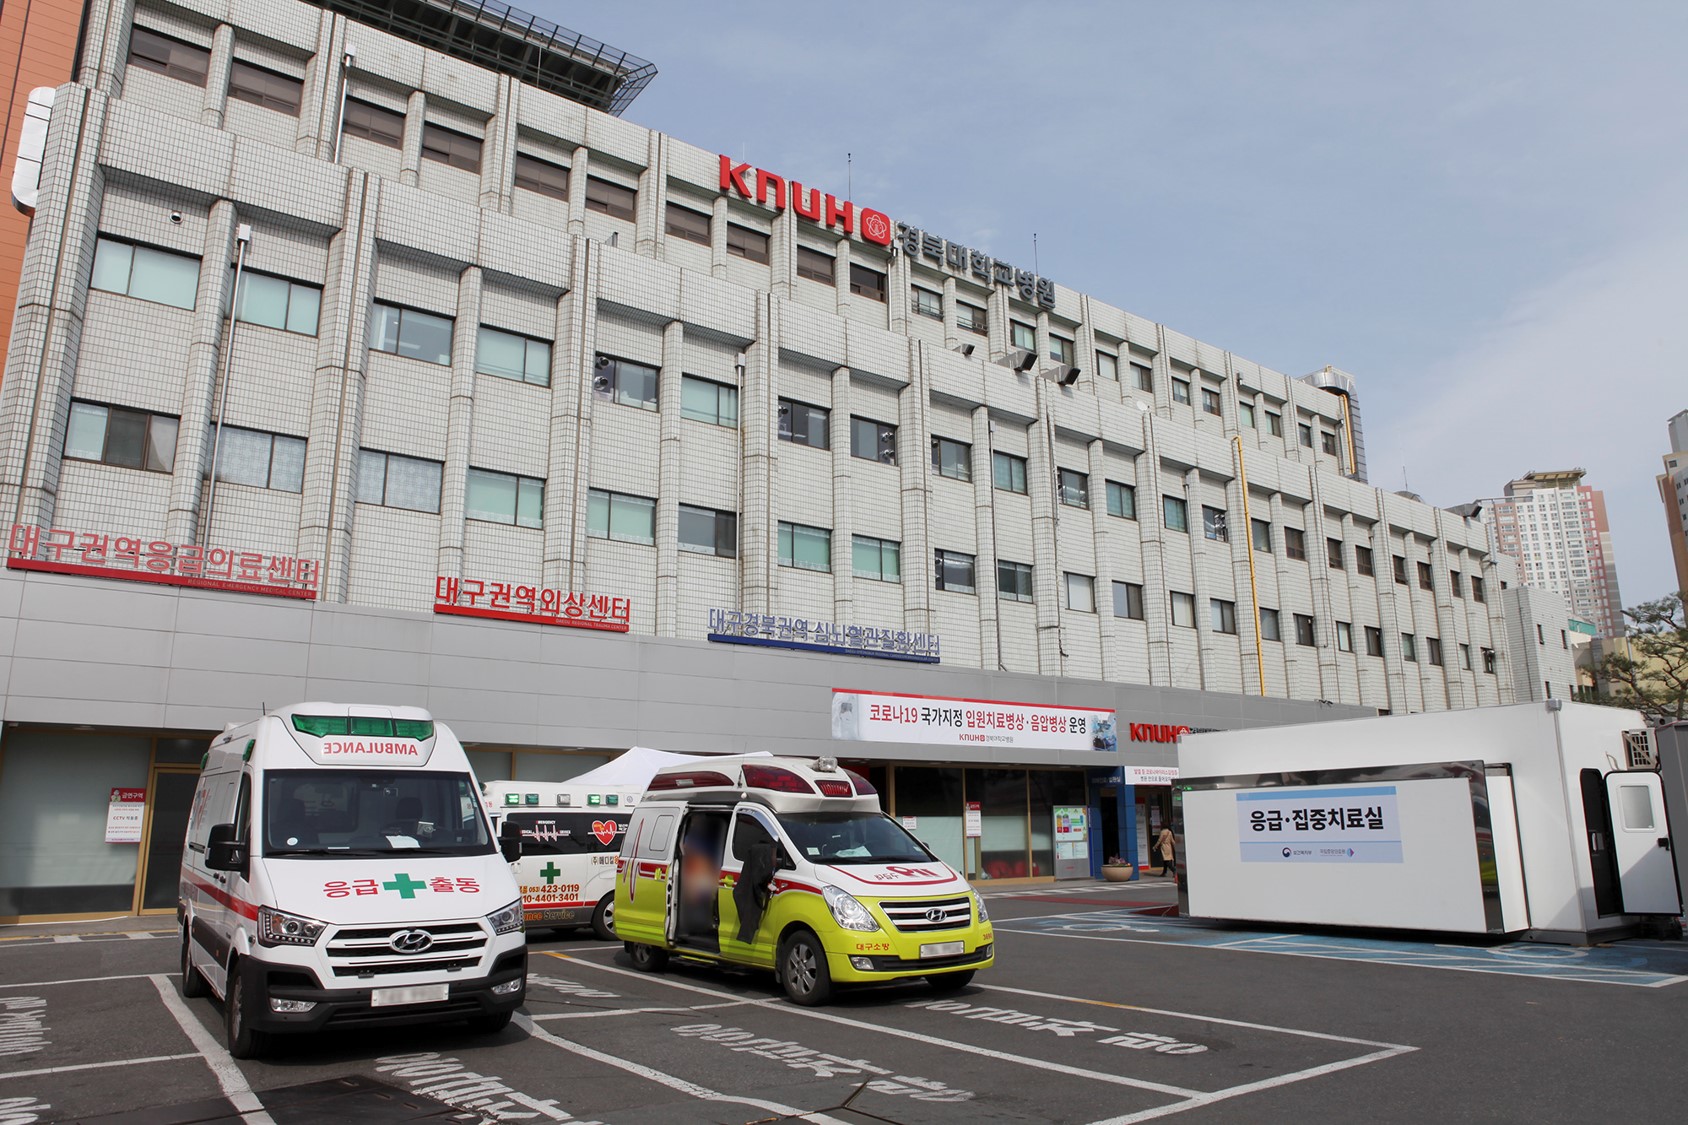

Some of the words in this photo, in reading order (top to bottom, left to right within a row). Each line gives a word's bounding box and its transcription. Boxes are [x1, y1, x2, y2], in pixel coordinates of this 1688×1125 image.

[719, 153, 854, 234] KNUH
[896, 220, 1056, 309] 경북대학교병원
[9, 523, 320, 588] 대구권역응급의료센터
[287, 589, 312, 597] CENTER
[435, 576, 631, 623] 대구권역외상센터
[708, 607, 808, 642] 대구경북권역
[812, 620, 940, 655] 심뇌혈관질환센터
[869, 703, 919, 724] 코로나19
[920, 706, 963, 729] 국가지정
[1068, 715, 1087, 735] 운영
[959, 733, 980, 742] KNUH
[1129, 722, 1177, 744] KNUH
[1249, 805, 1384, 832] 응급·집중치료실
[323, 879, 379, 898] 응급
[429, 877, 480, 894] 출동
[522, 893, 579, 903] 10-4401-3401
[540, 884, 580, 893] 423-0119
[543, 909, 575, 920] Service
[855, 943, 890, 951] 대구소방
